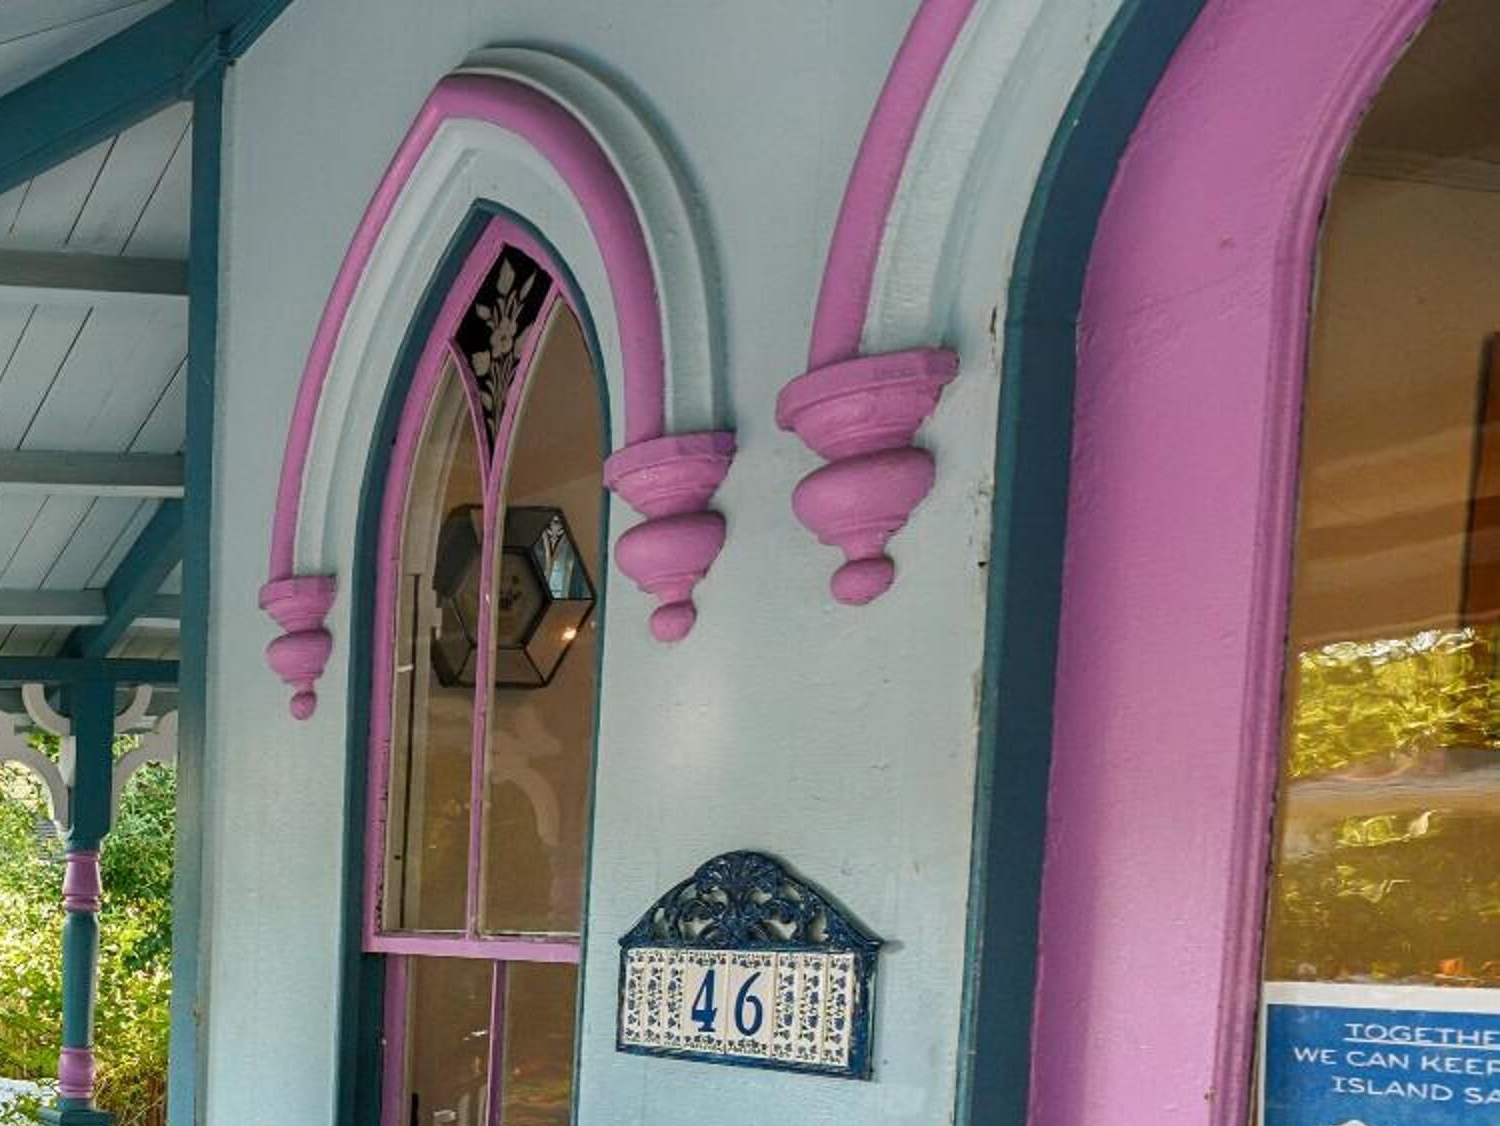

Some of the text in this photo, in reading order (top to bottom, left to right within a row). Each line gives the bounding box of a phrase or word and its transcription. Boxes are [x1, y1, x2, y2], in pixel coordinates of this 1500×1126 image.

[690, 968, 763, 1036] 46
[1293, 1047, 1337, 1065] WE
[1345, 1051, 1409, 1070] CAN
[1332, 1075, 1453, 1102] ISLAND
